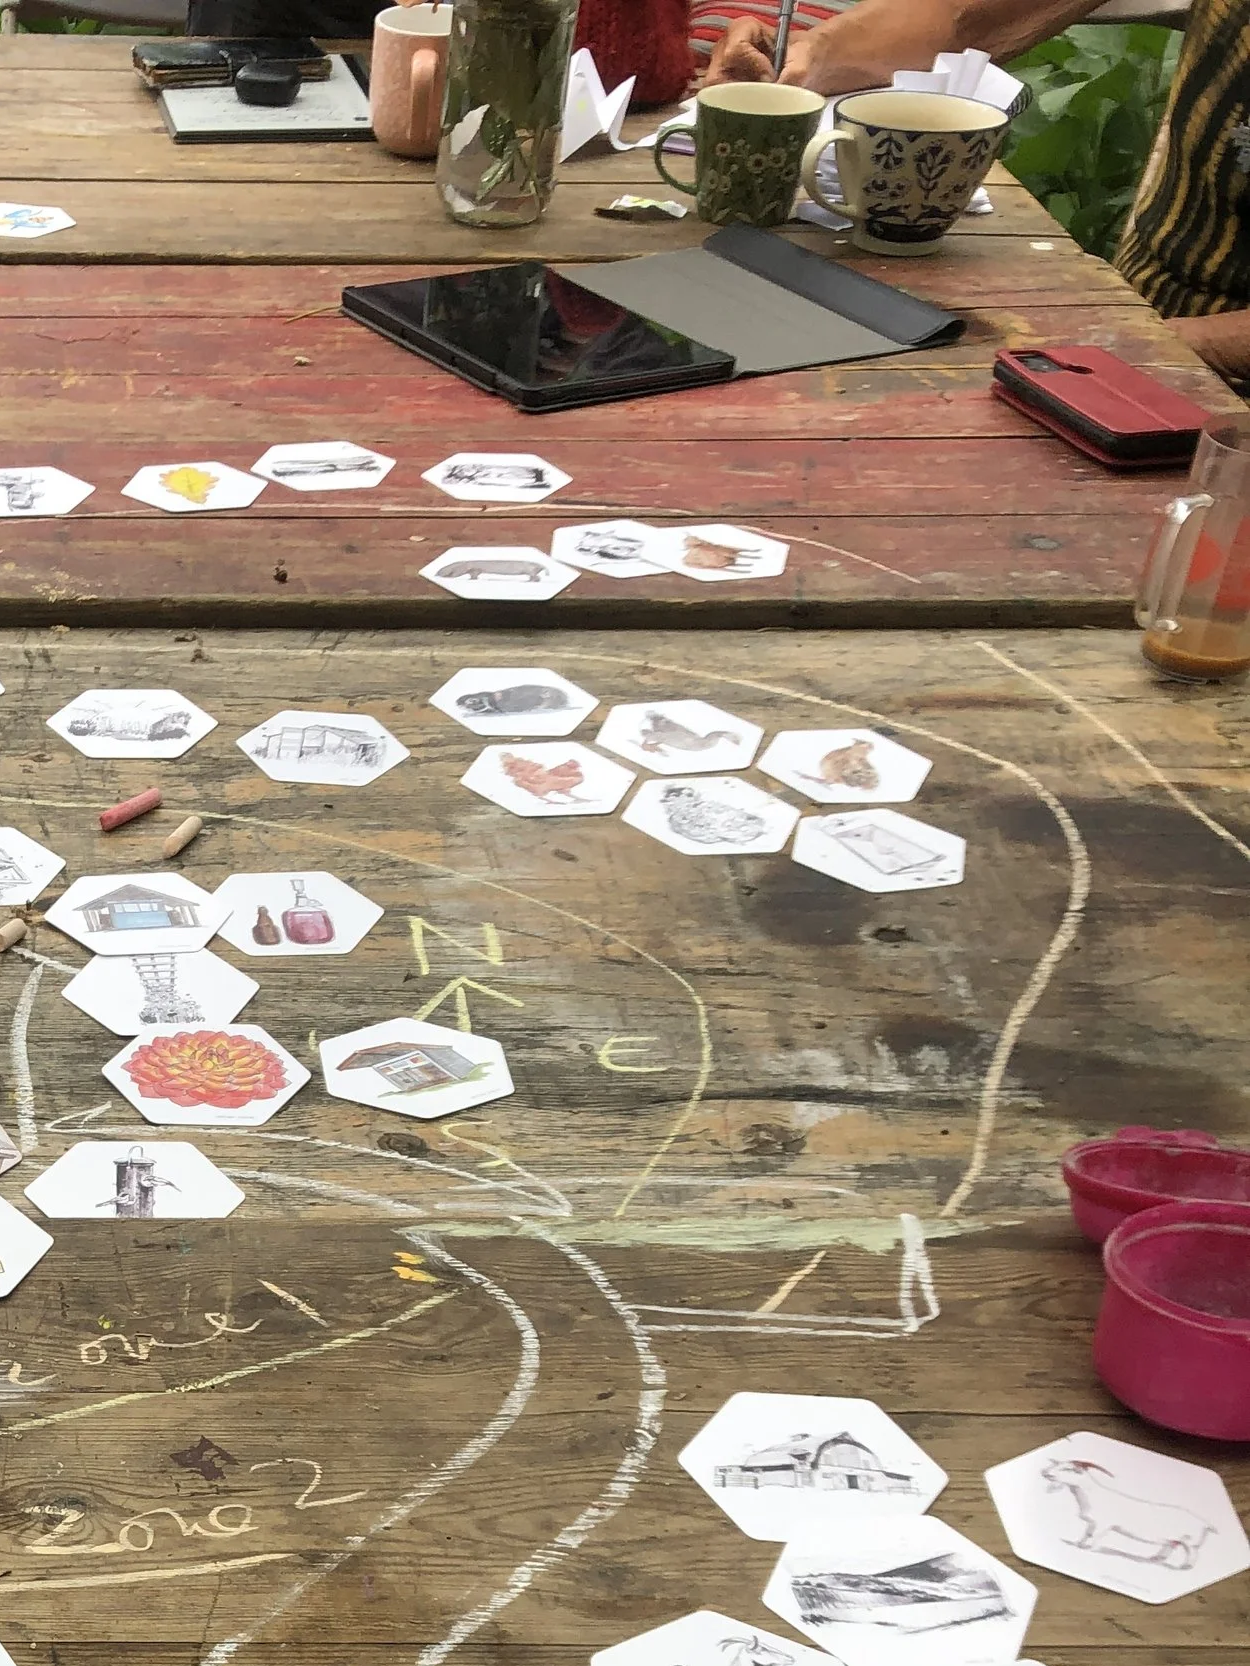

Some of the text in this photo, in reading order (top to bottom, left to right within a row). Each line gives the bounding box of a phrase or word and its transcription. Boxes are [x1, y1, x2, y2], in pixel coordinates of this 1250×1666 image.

[408, 915, 504, 975] N
[20, 1456, 369, 1556] Zone 2
